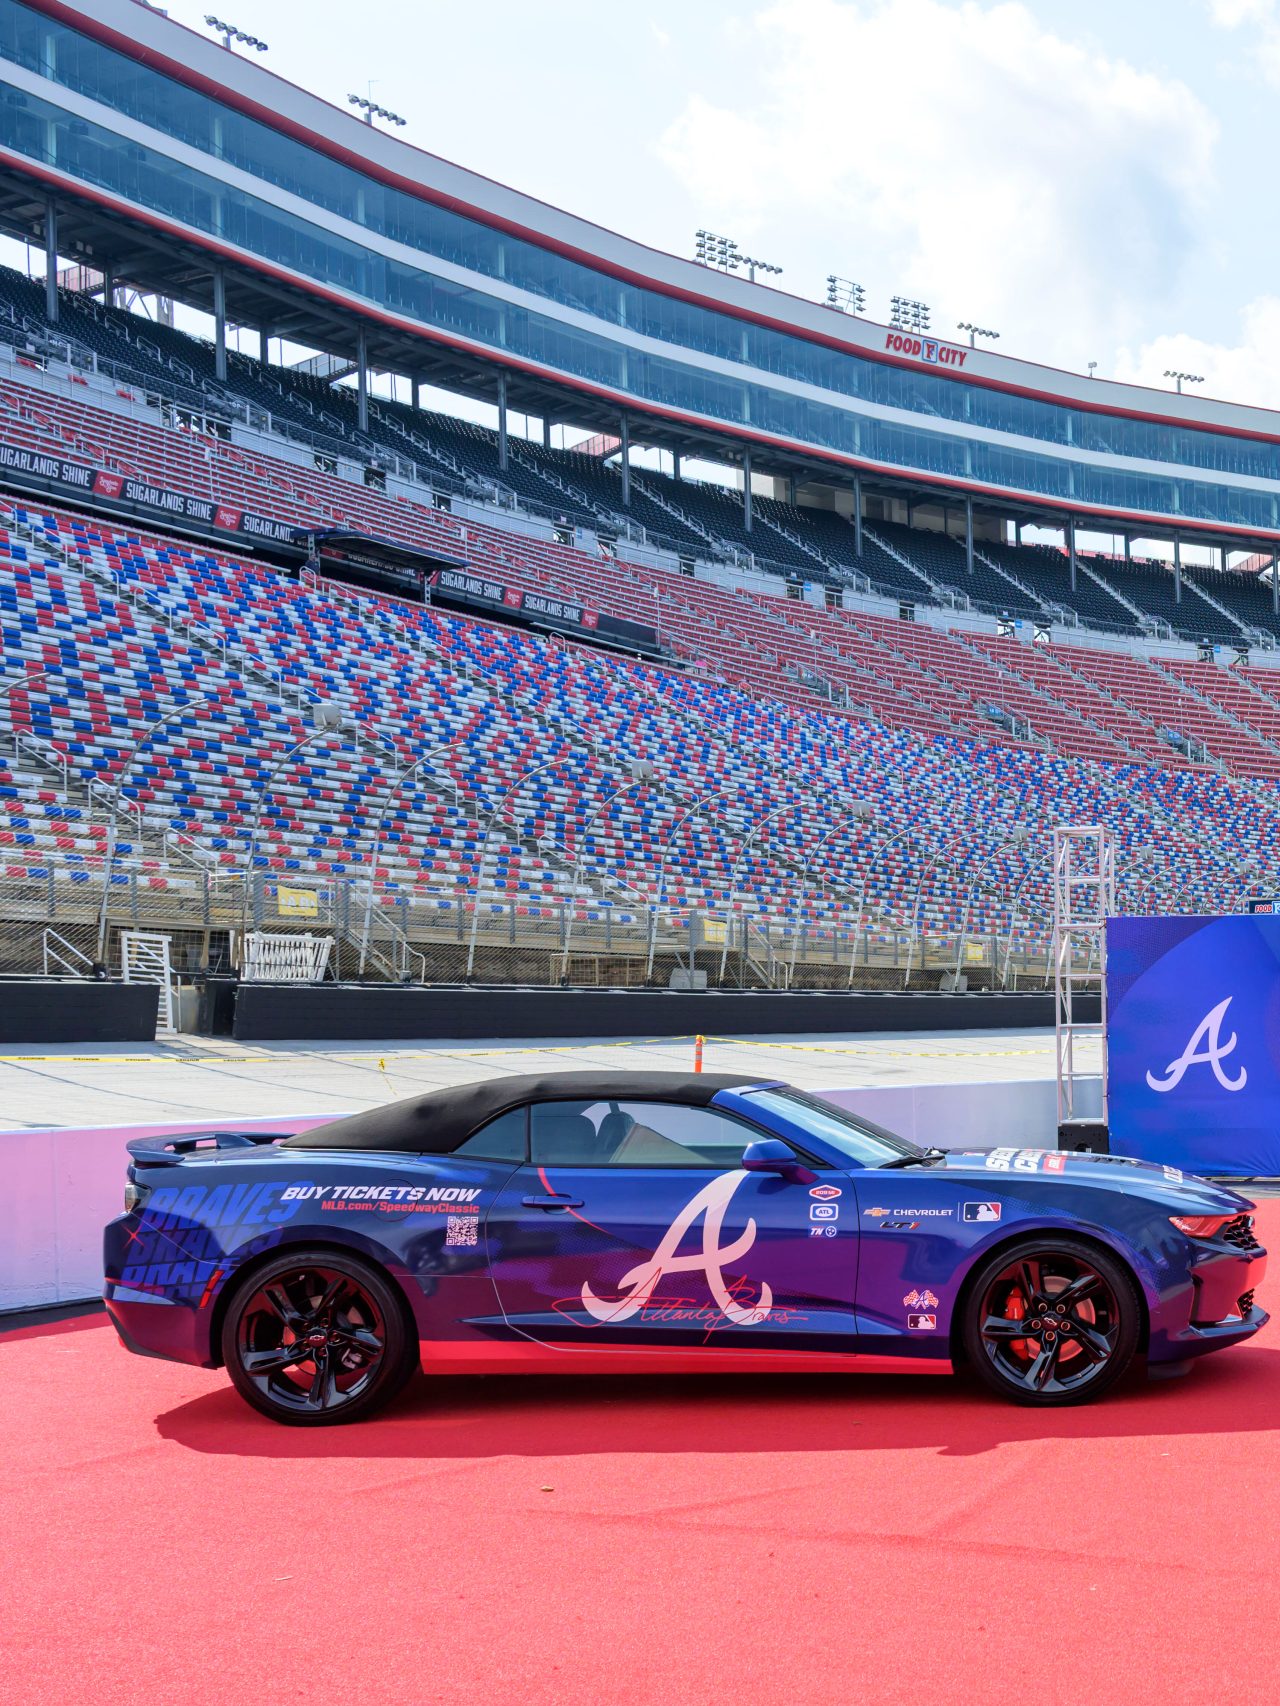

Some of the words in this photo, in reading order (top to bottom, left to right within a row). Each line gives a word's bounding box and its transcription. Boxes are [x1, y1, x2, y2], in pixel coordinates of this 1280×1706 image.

[886, 334, 921, 355] FOOD
[939, 347, 967, 366] CITY
[0, 446, 59, 478] UGARLANDS
[62, 464, 91, 487] SHINE
[126, 481, 184, 515] SUGARLANDS
[186, 500, 212, 521] SHINE
[441, 570, 482, 595] SUGARLANDS
[483, 584, 502, 600] SHINE
[525, 596, 562, 617] SUGARLANDS
[563, 606, 581, 622] SHINE
[1255, 905, 1273, 913] FOOD
[1146, 996, 1247, 1092] A
[140, 1180, 315, 1233] BRAVES
[280, 1186, 331, 1200] BUY
[332, 1186, 423, 1200] TICKETS
[425, 1187, 482, 1202] NOW
[321, 1201, 480, 1214] MLB.com/SpeedwayClassic
[581, 1168, 773, 1326] A
[811, 1227, 825, 1236] TN
